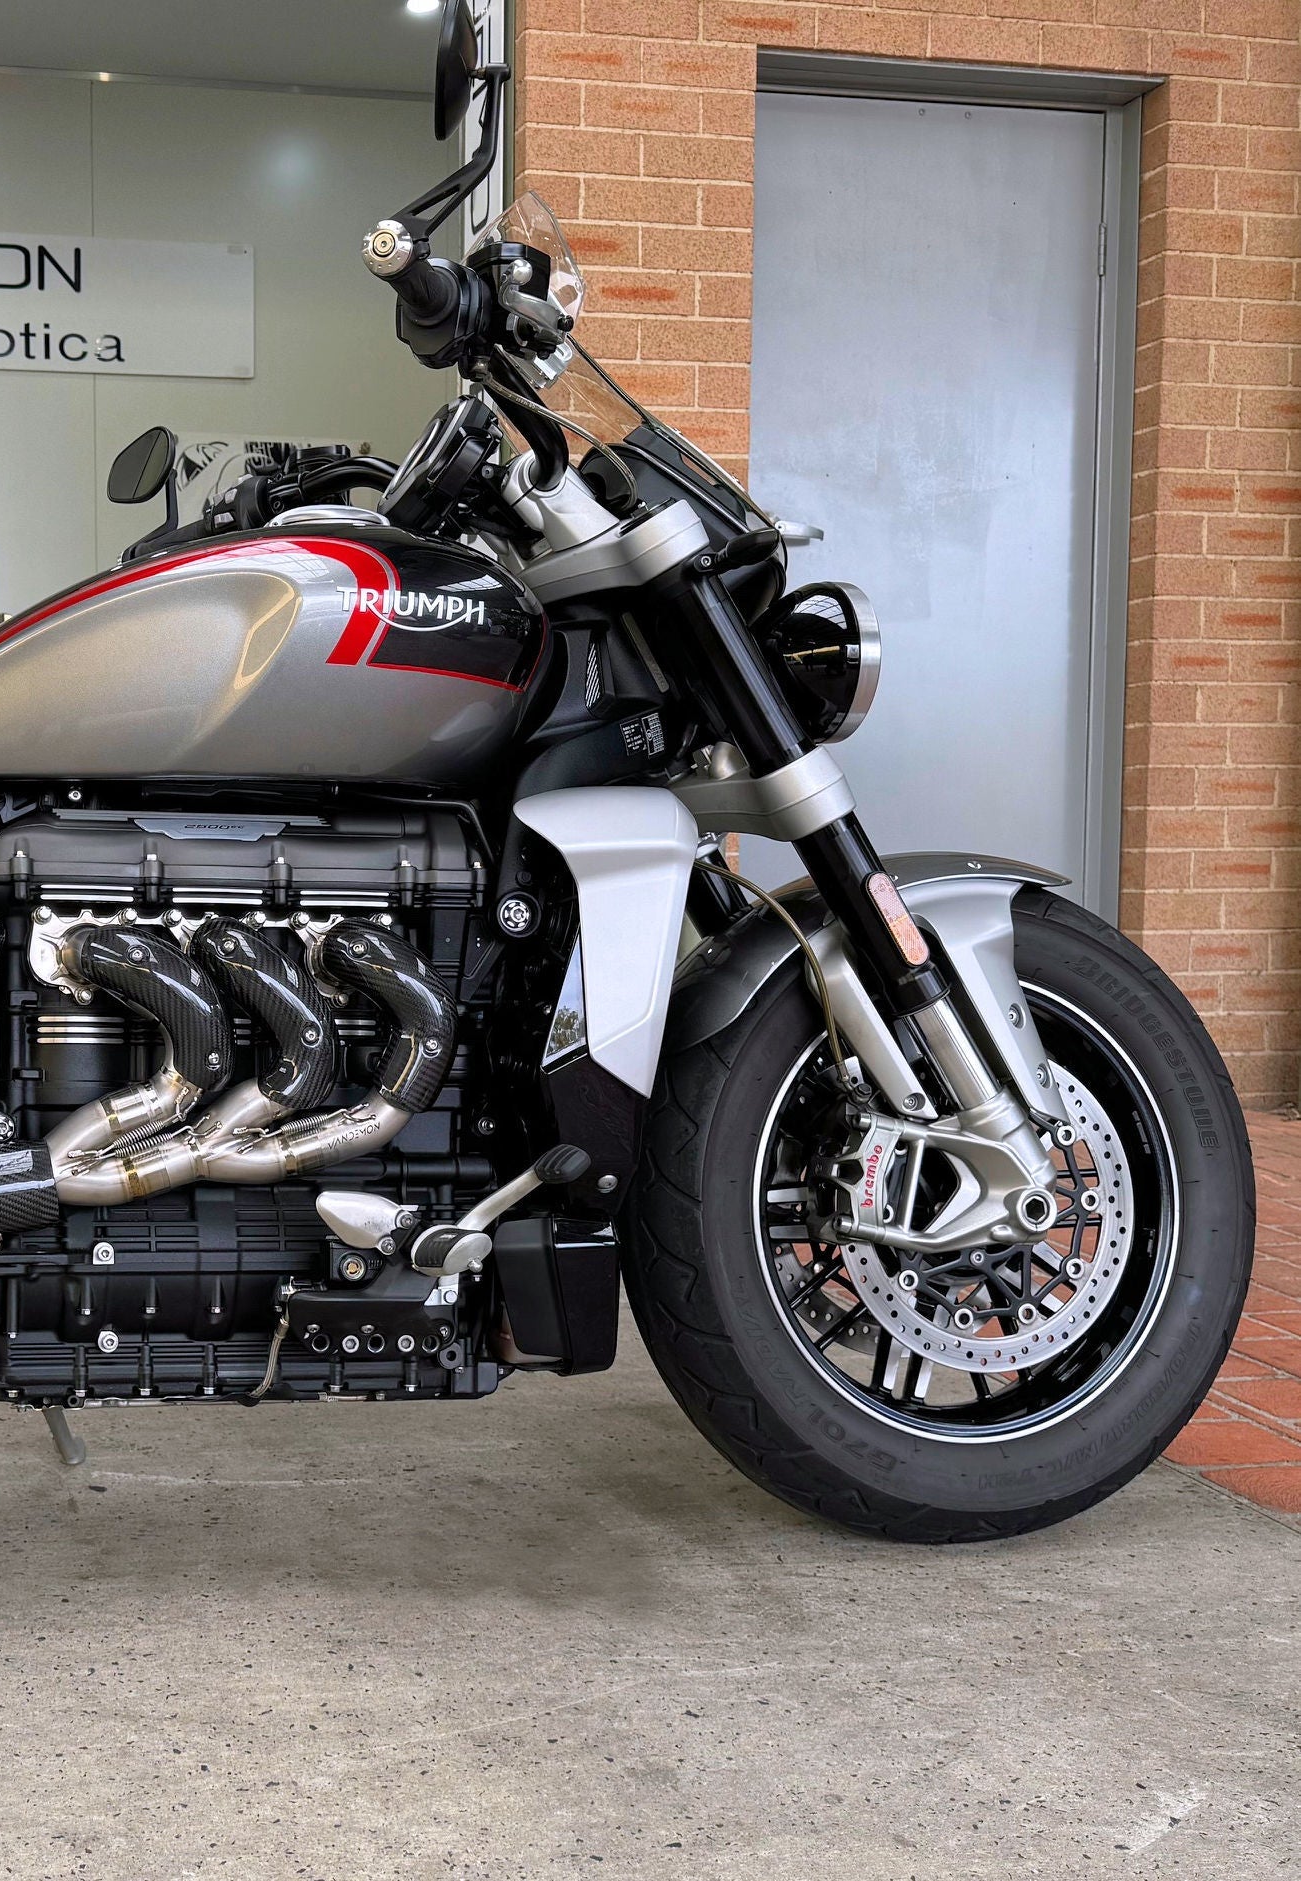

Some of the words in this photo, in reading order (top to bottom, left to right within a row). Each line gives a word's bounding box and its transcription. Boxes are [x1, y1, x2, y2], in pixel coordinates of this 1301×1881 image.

[336, 585, 485, 632] TRIUMPH
[327, 1122, 381, 1150] VANDEMON
[860, 1144, 883, 1209] brembo
